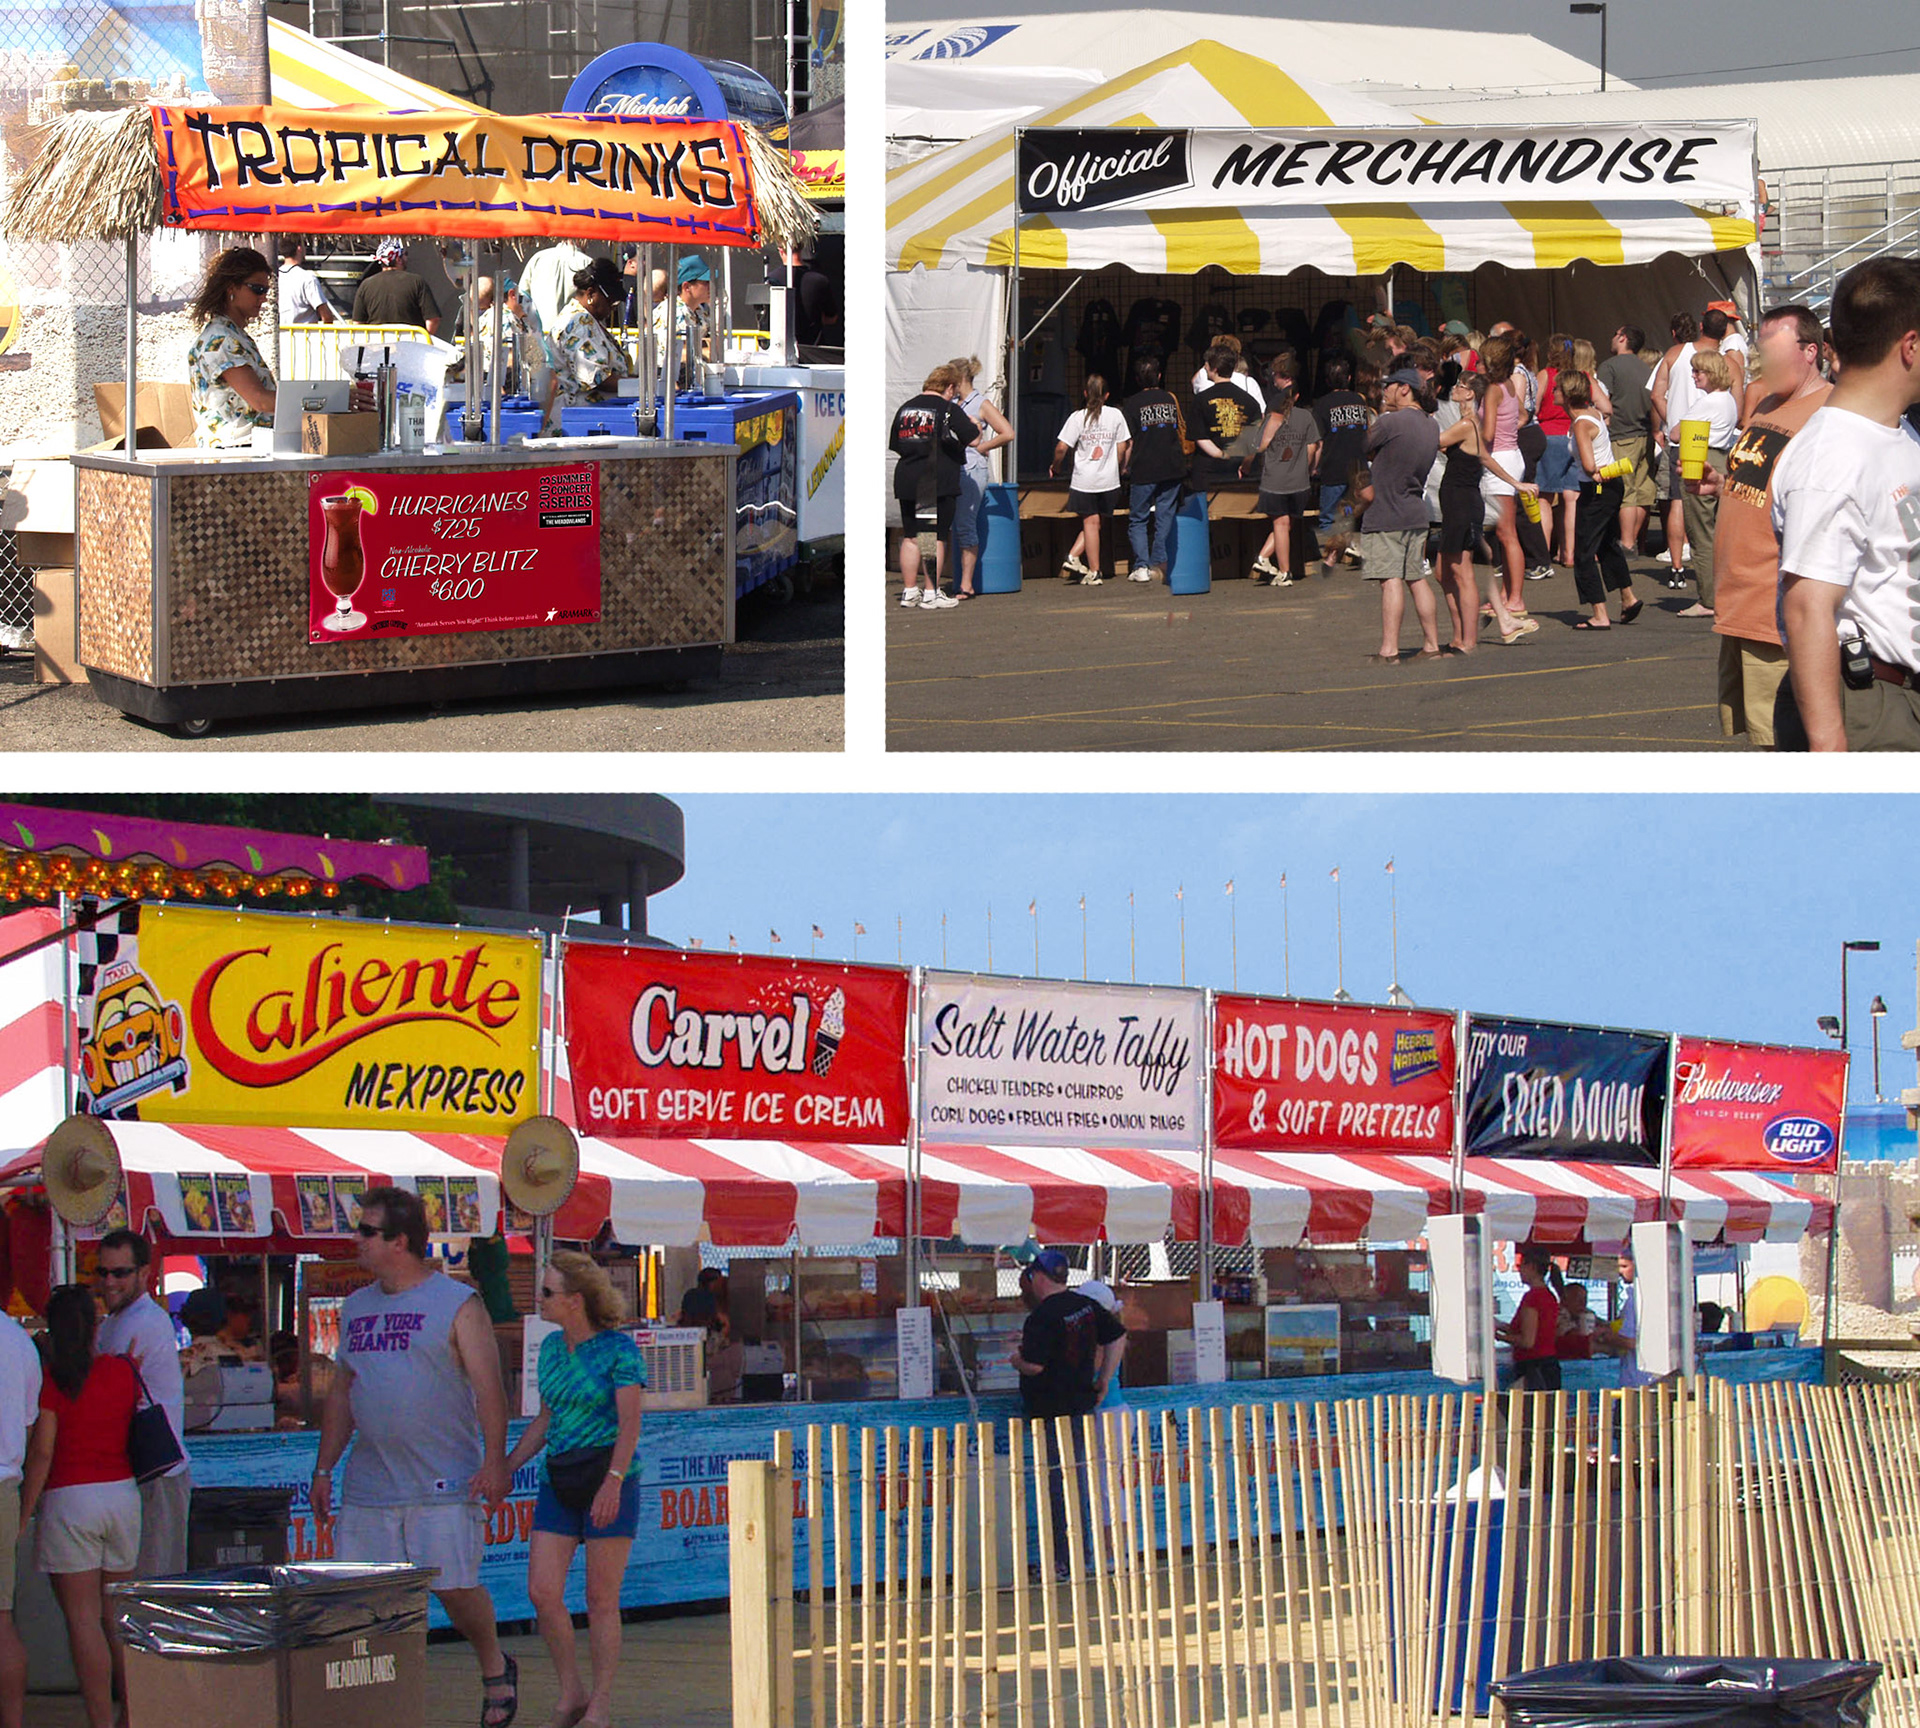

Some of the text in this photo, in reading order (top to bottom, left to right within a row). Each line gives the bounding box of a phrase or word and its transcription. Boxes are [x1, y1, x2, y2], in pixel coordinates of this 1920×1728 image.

[594, 93, 693, 115] Michelob
[184, 112, 737, 209] TROPICAL DRINKS
[1028, 135, 1718, 206] Official MERCHANDISE
[814, 393, 836, 418] ICE
[551, 473, 592, 485] SUMMER
[551, 483, 592, 496] CONCERT
[389, 490, 530, 517] HURRICANES
[540, 475, 550, 509] 2003
[551, 494, 592, 509] SERIES
[1890, 482, 1912, 502] THE
[380, 548, 539, 579] CHERRY BLITZ
[429, 578, 485, 601] $6.00
[558, 608, 593, 619] ARAMARK
[106, 965, 130, 984] TAXI
[190, 942, 520, 1089] Caliente
[630, 981, 812, 1074] Carvel
[930, 1002, 1192, 1097] Salt Water Taffy
[1223, 1017, 1380, 1087] HOT DOGS
[1397, 1033, 1434, 1051] HEBREW
[1393, 1049, 1438, 1071] NATIONAL
[1466, 1032, 1528, 1093] TRY OUR
[345, 1062, 525, 1116] MEXPRESS
[947, 1076, 1124, 1101] CHICKEN TENDERS CHURROS
[1675, 1061, 1784, 1106] Budweiser
[588, 1086, 886, 1129] SOFT SERVE ICE CREAM
[931, 1105, 1186, 1132] CORN DOGS FRENCH FRIES ONION RINGS
[1248, 1087, 1441, 1140] & SOFT PRETZELS
[1502, 1070, 1645, 1146] FRIED DOUGH
[1779, 1122, 1821, 1137] BUD
[1770, 1138, 1826, 1154] LIGHT
[348, 1313, 426, 1335] NEW YORK
[347, 1332, 410, 1353] GIANTS
[682, 1455, 704, 1478] THE
